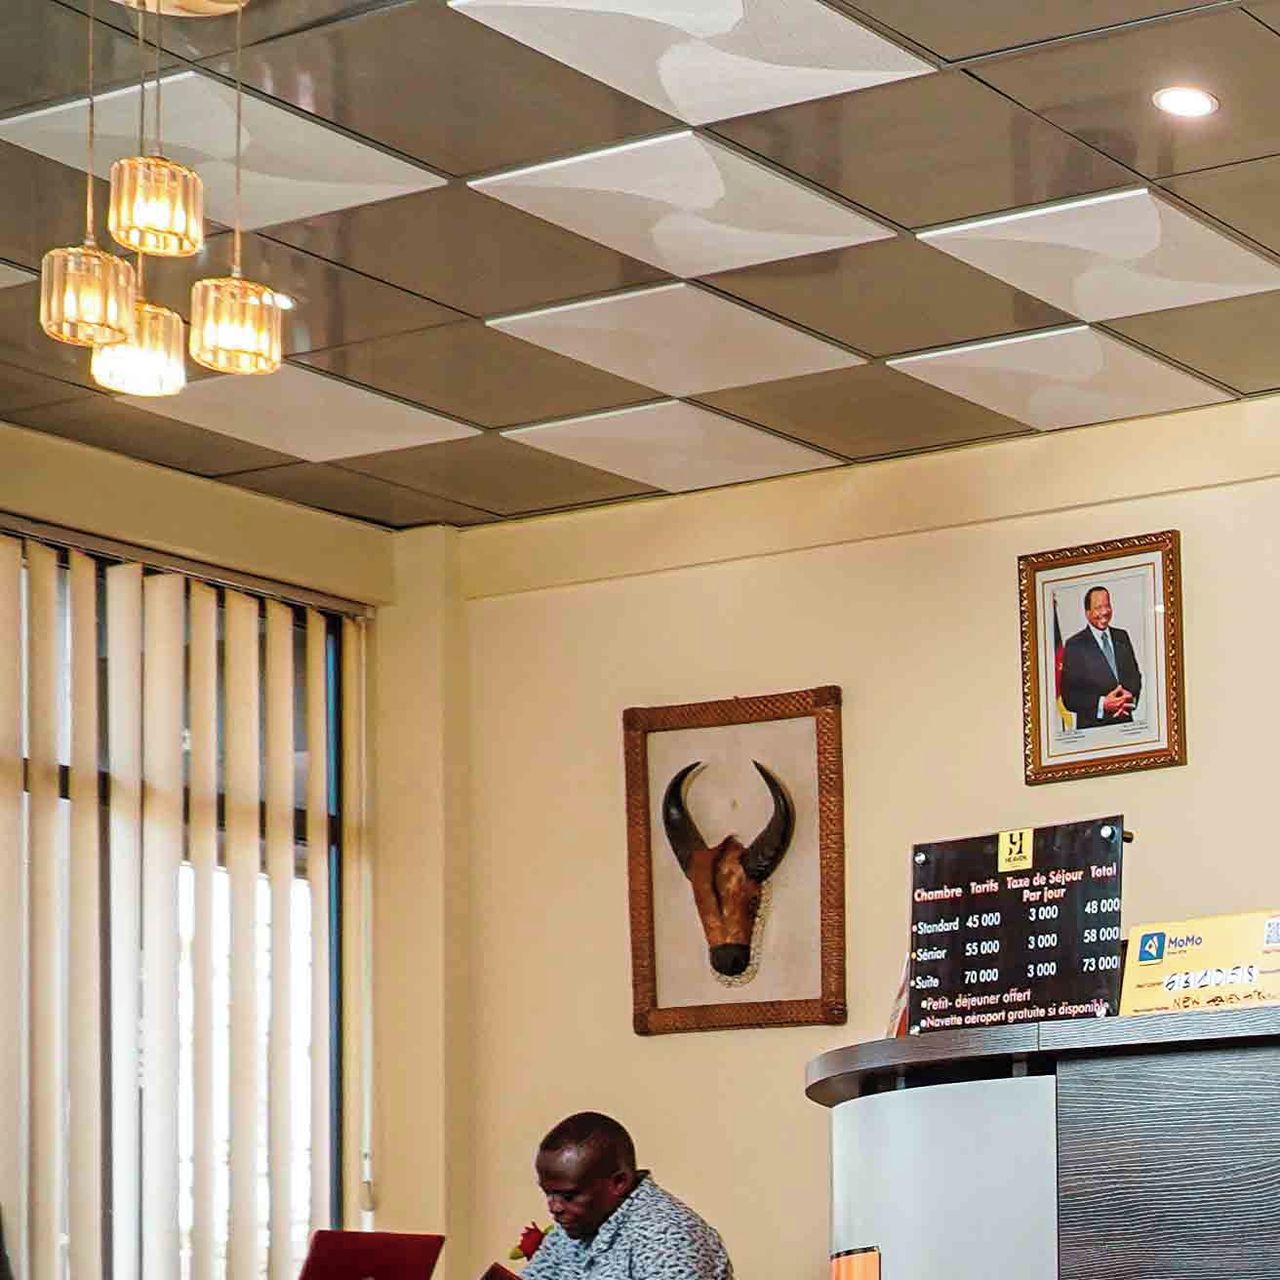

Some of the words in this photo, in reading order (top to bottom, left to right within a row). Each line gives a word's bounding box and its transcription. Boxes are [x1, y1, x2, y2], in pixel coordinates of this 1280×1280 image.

[914, 885, 962, 902] Chambre
[970, 878, 999, 895] Tarifs
[1006, 875, 1030, 890] Taxe
[1033, 872, 1047, 886] de
[1090, 862, 1117, 878] Total
[1022, 888, 1040, 903] Par
[1043, 886, 1066, 904] jour
[917, 916, 960, 936] Standard
[966, 914, 980, 928] 45
[981, 912, 1001, 926] 000
[1029, 907, 1037, 921] 3
[1038, 905, 1059, 920] 000
[1085, 900, 1099, 914] 48
[1100, 897, 1120, 912] 000
[965, 942, 978, 957] 55
[980, 940, 1000, 955] 000
[1028, 936, 1036, 949] 3
[1037, 933, 1058, 948] 000
[1083, 928, 1097, 943] 58
[1099, 926, 1120, 941] 000
[1167, 935, 1203, 949] MoMo
[915, 975, 940, 990] Suite
[964, 970, 978, 984] 70
[979, 968, 999, 983] 000
[1027, 964, 1035, 978] 3
[1036, 962, 1057, 977] 000
[1082, 958, 1096, 972] 73
[1002, 988, 1032, 1004] offert
[926, 1014, 963, 1029] Navette
[1007, 1006, 1046, 1023] gratuite
[1047, 1003, 1056, 1017] si
